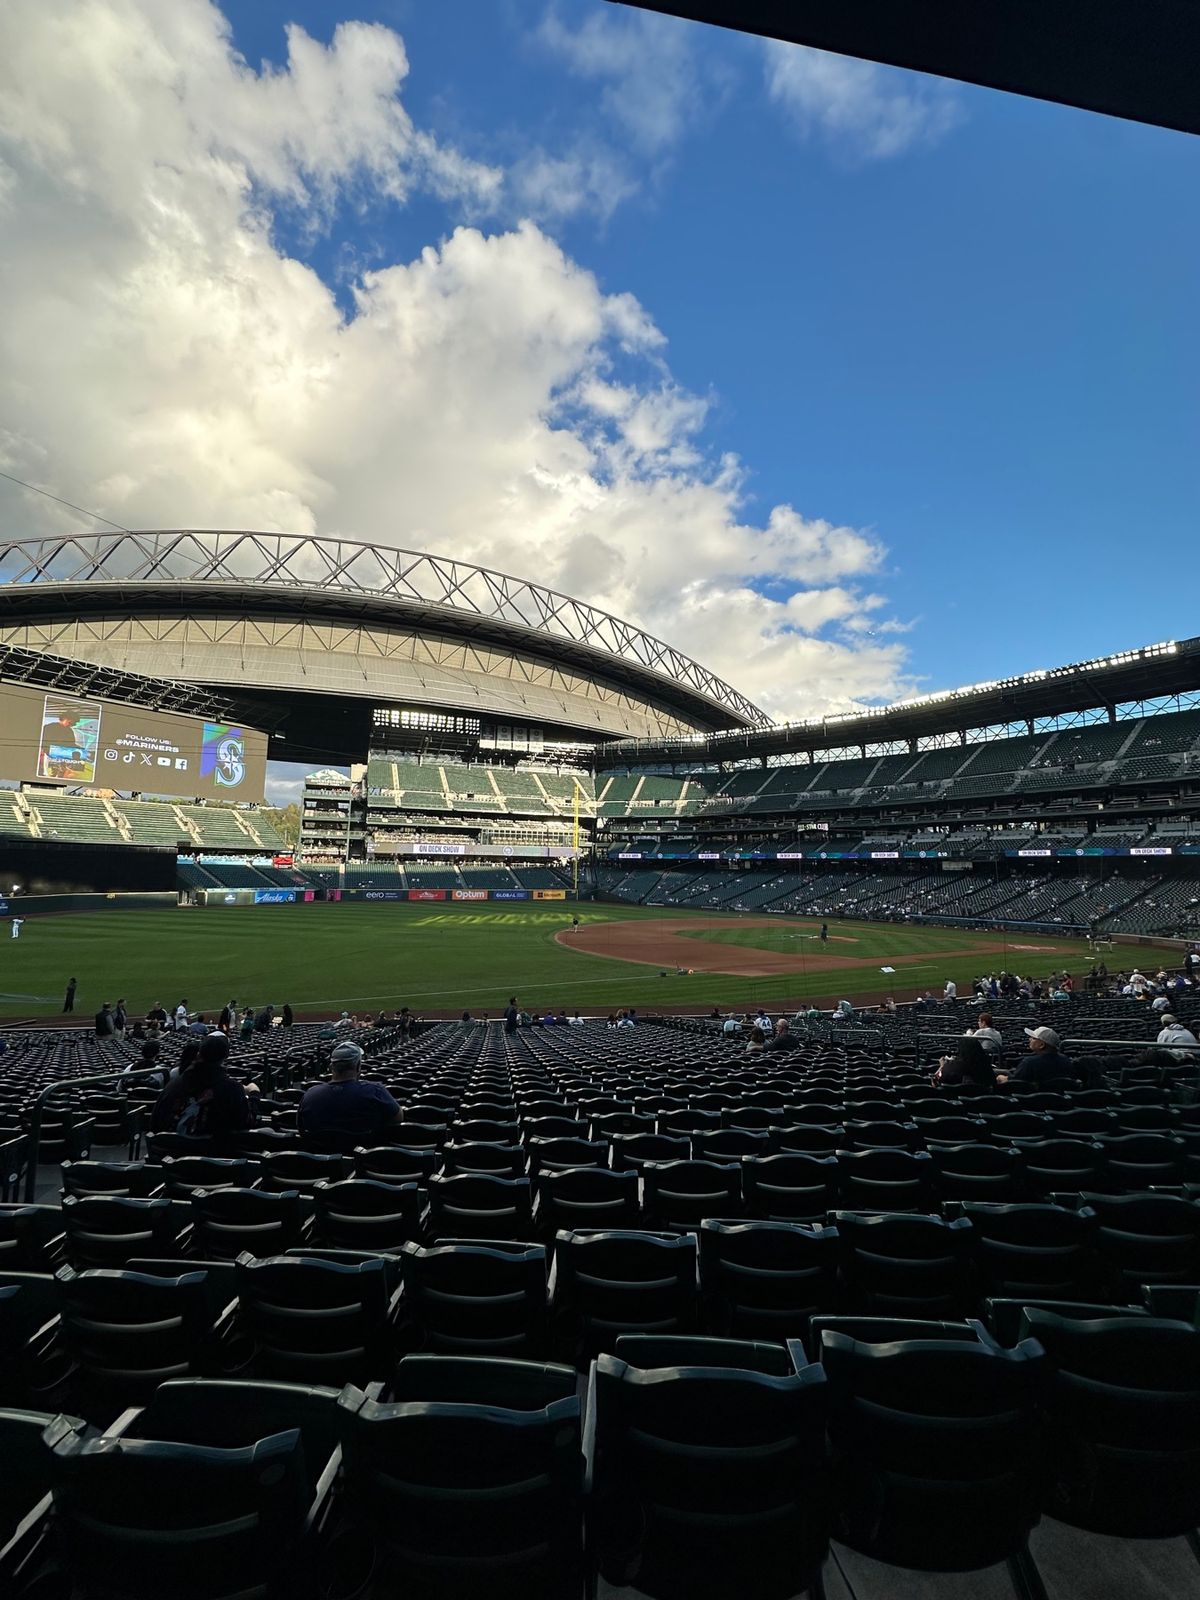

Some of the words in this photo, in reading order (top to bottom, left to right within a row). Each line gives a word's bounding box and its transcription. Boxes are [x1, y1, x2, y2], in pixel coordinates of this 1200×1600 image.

[126, 733, 158, 743] FOLLOW
[116, 738, 180, 753] @MARINERS
[256, 893, 285, 903] Alaska
[455, 890, 485, 900] Optum
